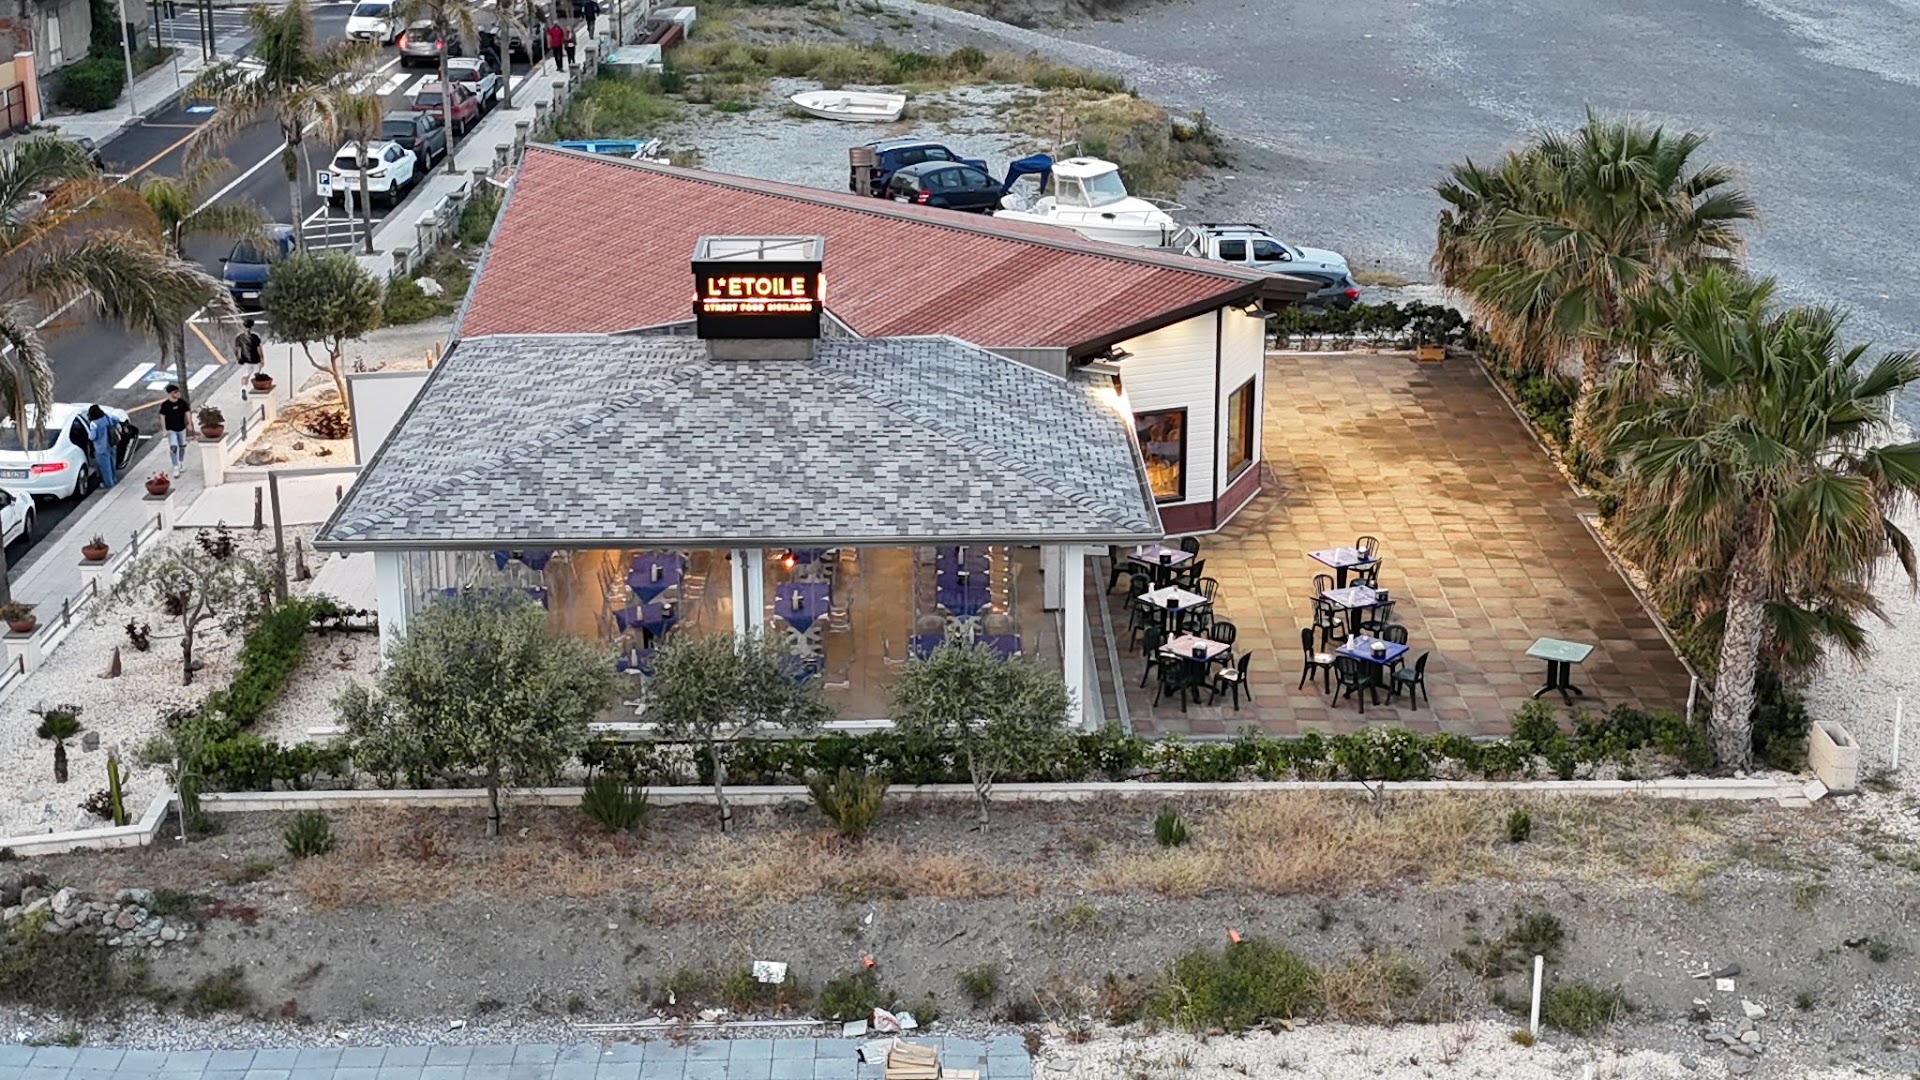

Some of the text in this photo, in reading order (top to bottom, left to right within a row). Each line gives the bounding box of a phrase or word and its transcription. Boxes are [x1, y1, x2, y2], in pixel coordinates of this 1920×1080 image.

[321, 174, 328, 183] P
[704, 303, 738, 312] STREET
[740, 303, 765, 312] FOOD
